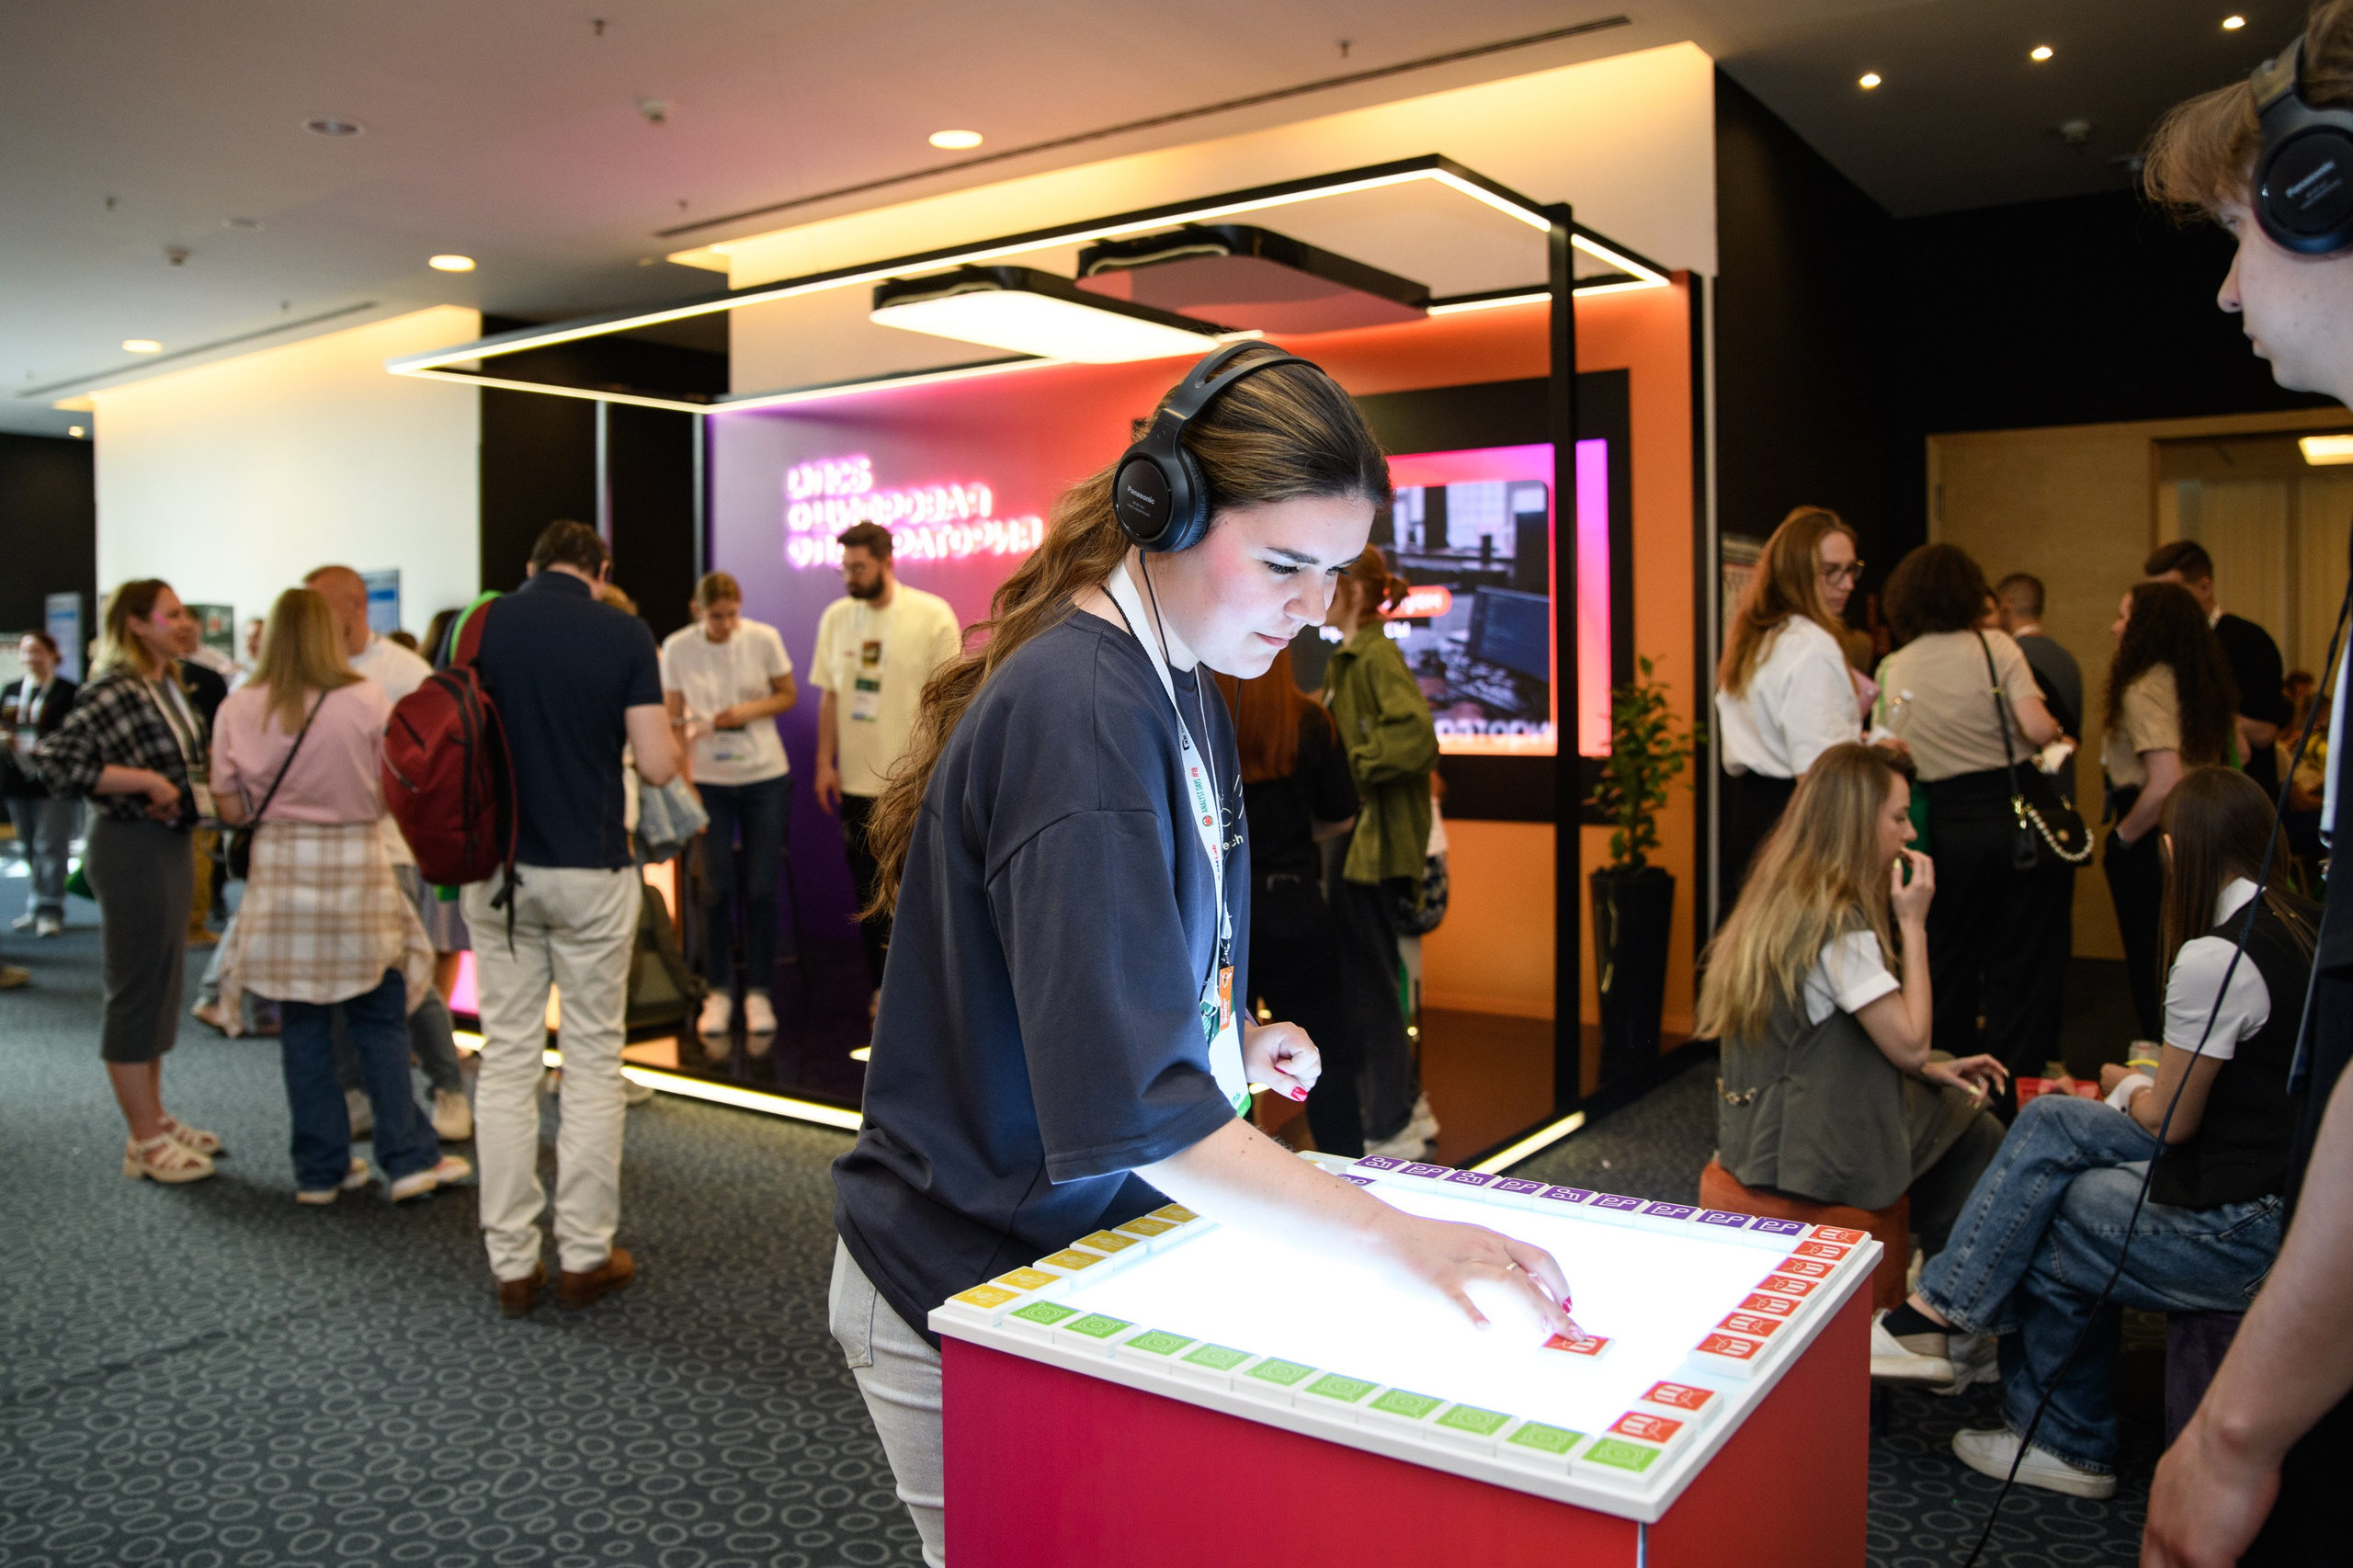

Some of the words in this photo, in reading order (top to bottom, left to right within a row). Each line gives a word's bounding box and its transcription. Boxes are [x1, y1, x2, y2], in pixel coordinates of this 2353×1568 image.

[1127, 485, 1155, 505] Panasonic
[1194, 778, 1204, 791] DAYS
[1197, 791, 1209, 813] ANALYST
